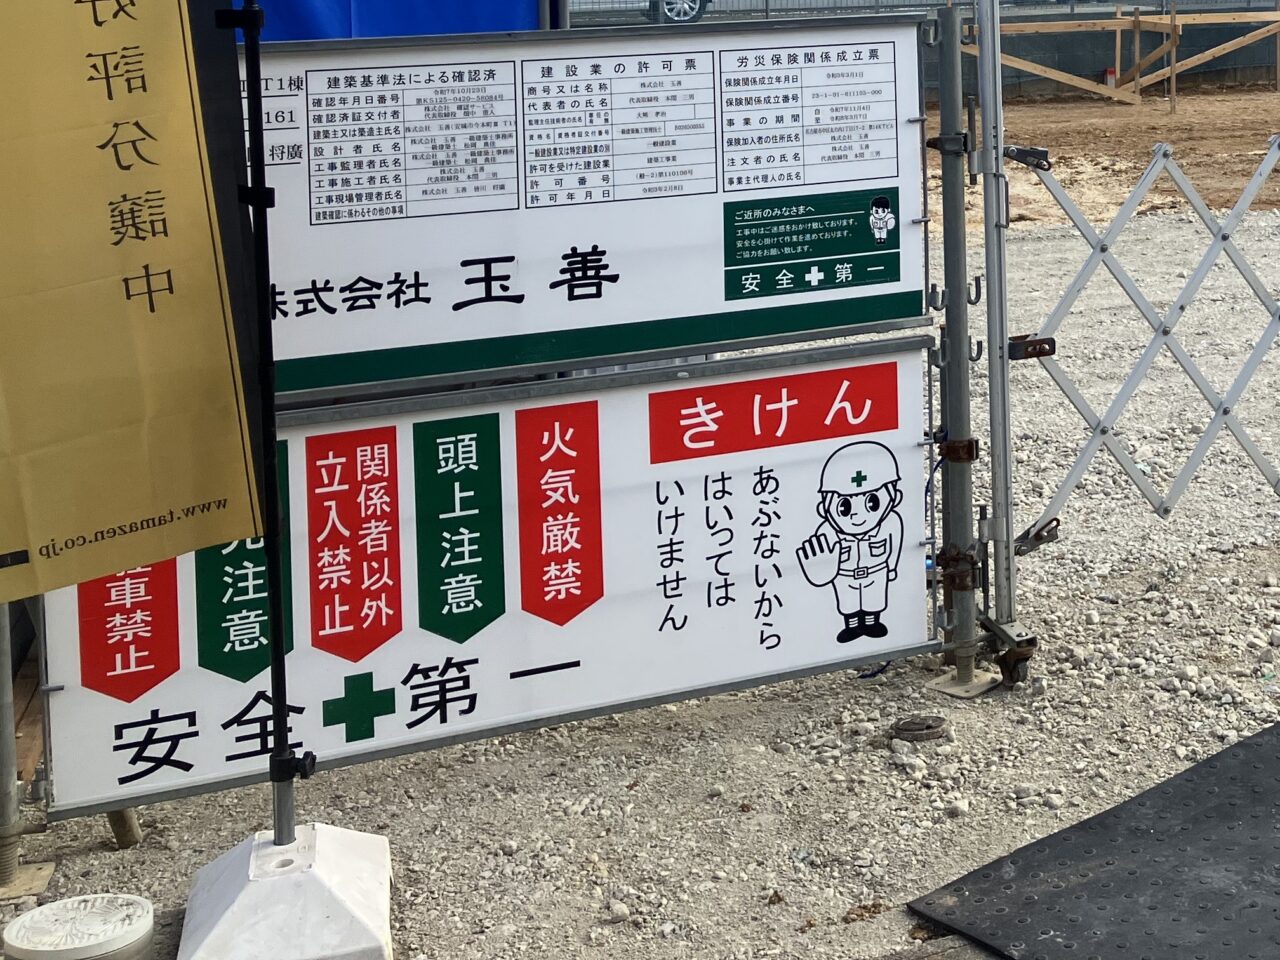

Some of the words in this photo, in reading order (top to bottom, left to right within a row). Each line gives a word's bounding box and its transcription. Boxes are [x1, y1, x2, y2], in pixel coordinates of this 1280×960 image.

[737, 48, 881, 68] 労災保険関係成立票
[541, 58, 697, 79] 建設業の許可票
[326, 68, 497, 90] 建築基準法による確認済
[724, 75, 799, 88] 保険関係成立年月日
[527, 82, 608, 97] 商号又は名称
[312, 93, 400, 108] 確認年月日番号
[528, 98, 608, 112] 代表者の氏名
[725, 93, 800, 107] 保険関係成立番号
[312, 109, 400, 124] 確認済証交付者
[726, 113, 800, 127] 事業の期間
[313, 126, 401, 140] 建築主又は築造主氏名
[726, 133, 801, 147] 保険加入者の住所氏名
[313, 142, 401, 157] 設計者氏名
[314, 158, 402, 172] 工事監理者氏名
[529, 159, 611, 174] 許可を受けた建設業
[727, 152, 801, 167] 注文者の氏名
[314, 174, 402, 189] 工事施工者氏名
[530, 174, 611, 190] 許可番号
[727, 171, 802, 186] 事業主代理人の氏名
[315, 190, 403, 205] 工事現場管理者氏名
[530, 190, 610, 205] 許可年月日
[735, 204, 815, 221] ご近所のみなさまへ
[452, 244, 620, 312] 玉善
[741, 269, 795, 294] 安全
[834, 262, 885, 283] 第一
[679, 380, 872, 449] きけん
[539, 421, 582, 602] 火気厳禁
[436, 432, 484, 615] 頭上注意
[314, 450, 354, 636] 立入禁止
[356, 443, 394, 629] 関係者以外
[703, 471, 736, 608] はいっては
[656, 480, 688, 632] いけません
[751, 465, 783, 650] あぶないから
[104, 566, 155, 677] 車禁止
[112, 690, 306, 786] 安全
[400, 656, 581, 730] 第一
